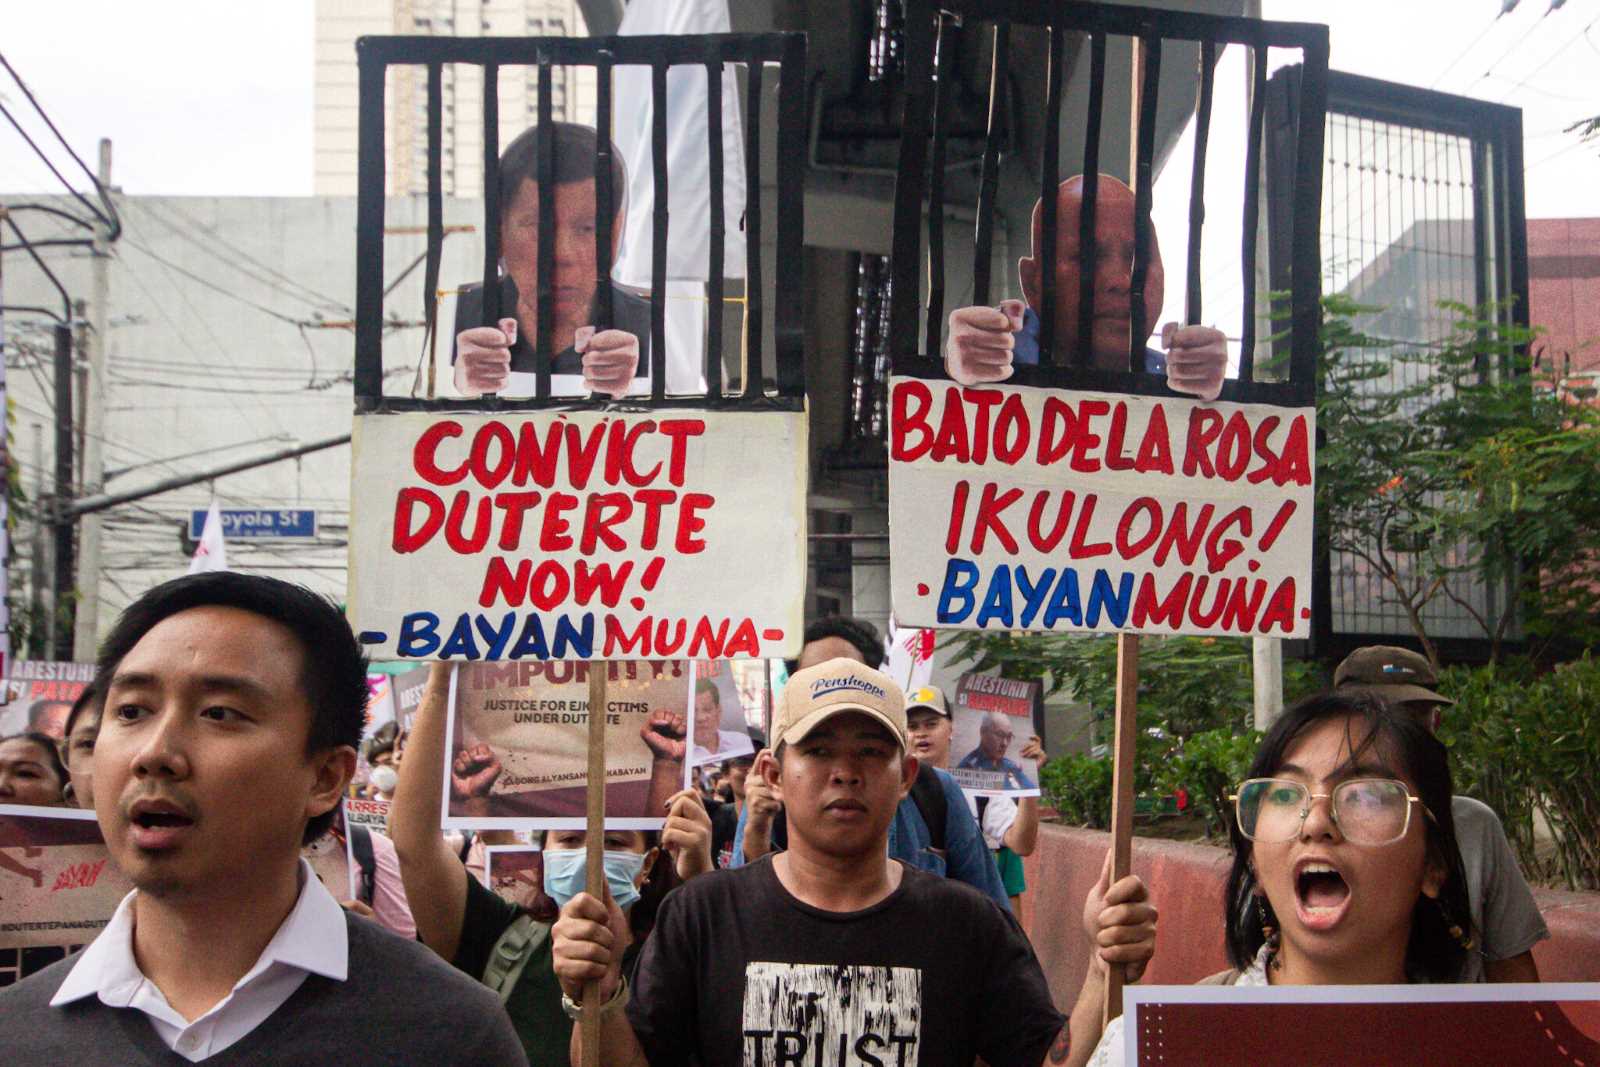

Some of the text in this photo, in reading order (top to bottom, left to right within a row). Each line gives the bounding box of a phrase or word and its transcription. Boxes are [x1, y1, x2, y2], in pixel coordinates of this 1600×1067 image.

[413, 418, 706, 490] CONVICT
[891, 380, 1031, 466] BATO
[1182, 406, 1312, 487] ROSA
[220, 508, 299, 530] oyola St
[392, 487, 716, 556] DUTERTE
[946, 480, 1298, 573] IKULONG!
[479, 556, 666, 611] NOW!
[484, 699, 537, 711] JUSTICE
[540, 700, 566, 711] FOR
[607, 702, 649, 713] CTIMS
[514, 713, 620, 725] UNDER DUTTE
